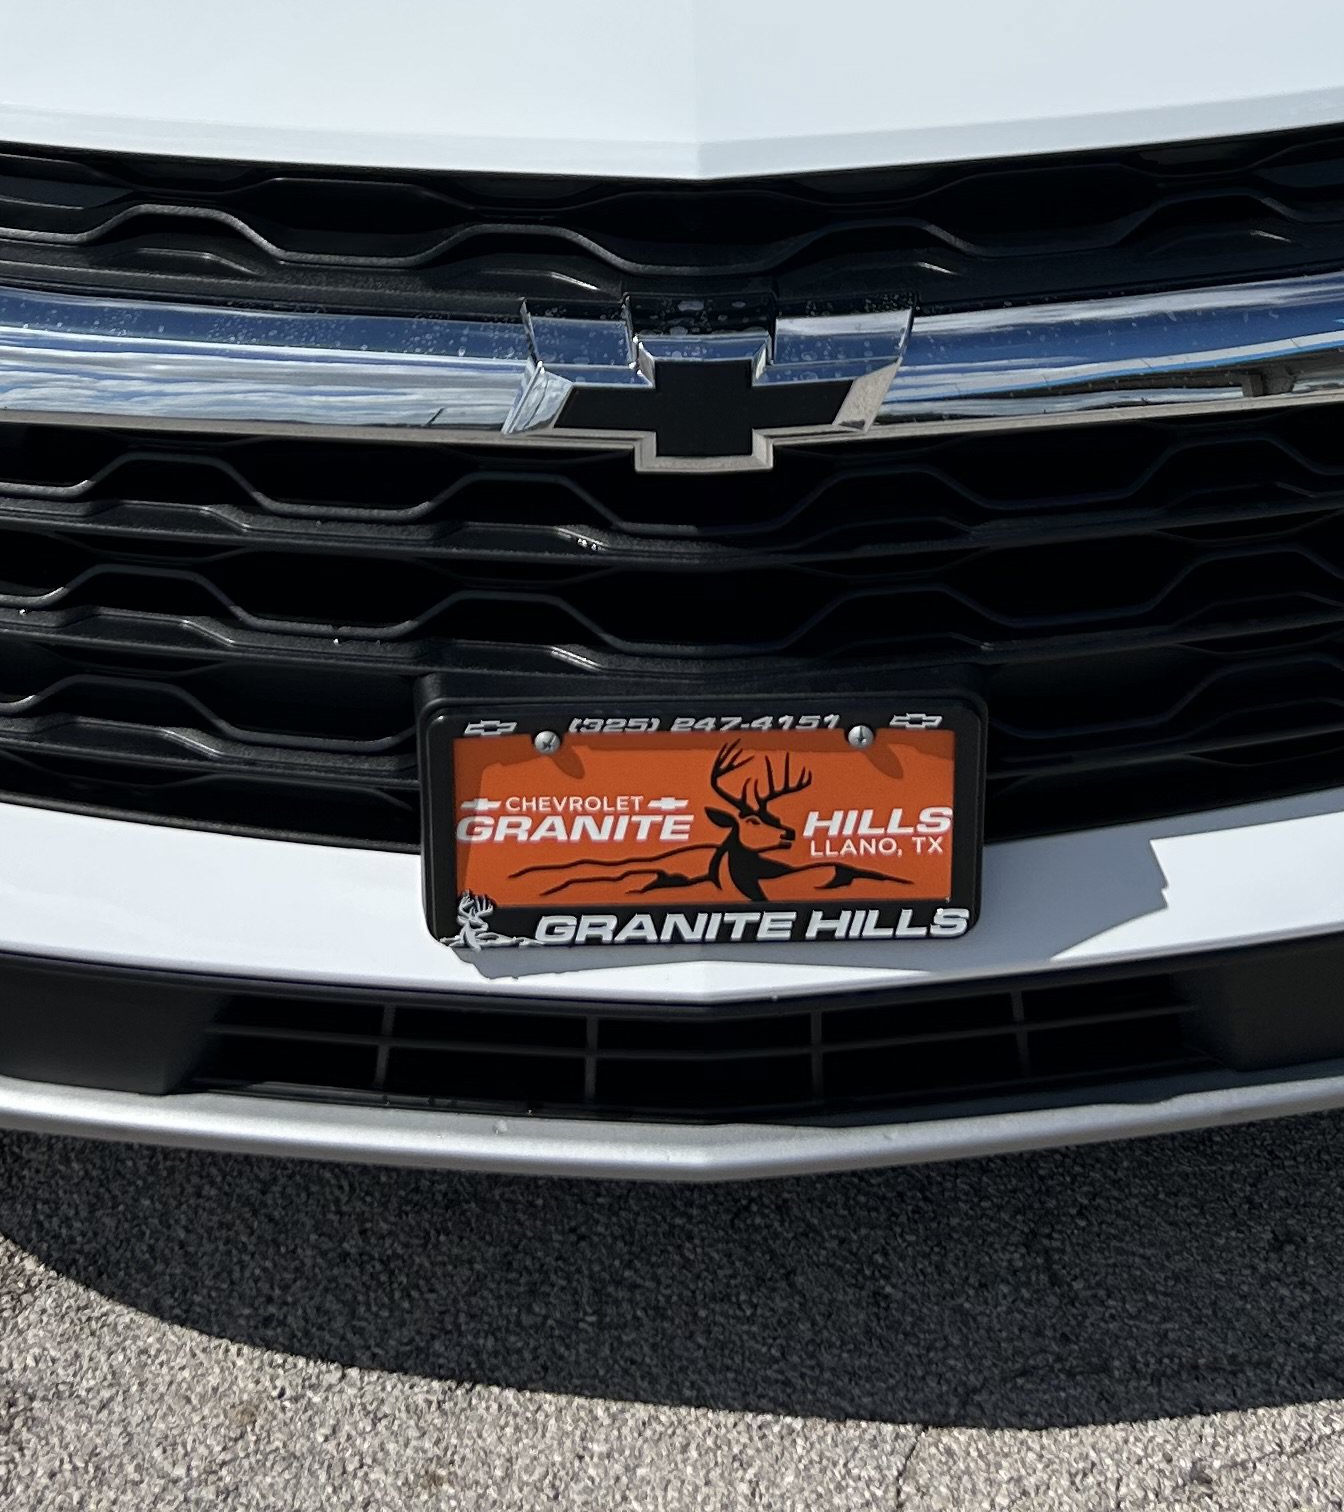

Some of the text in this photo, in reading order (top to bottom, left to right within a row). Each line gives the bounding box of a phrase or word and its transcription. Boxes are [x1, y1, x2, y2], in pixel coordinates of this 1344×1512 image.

[569, 714, 840, 733] (325) 247-4151
[505, 795, 644, 812] CHEVROLET
[456, 814, 695, 843] GRANITE
[803, 807, 954, 838] HILLS
[810, 836, 944, 857] LLANO, TX
[536, 907, 970, 945] GRANITE HILLS
